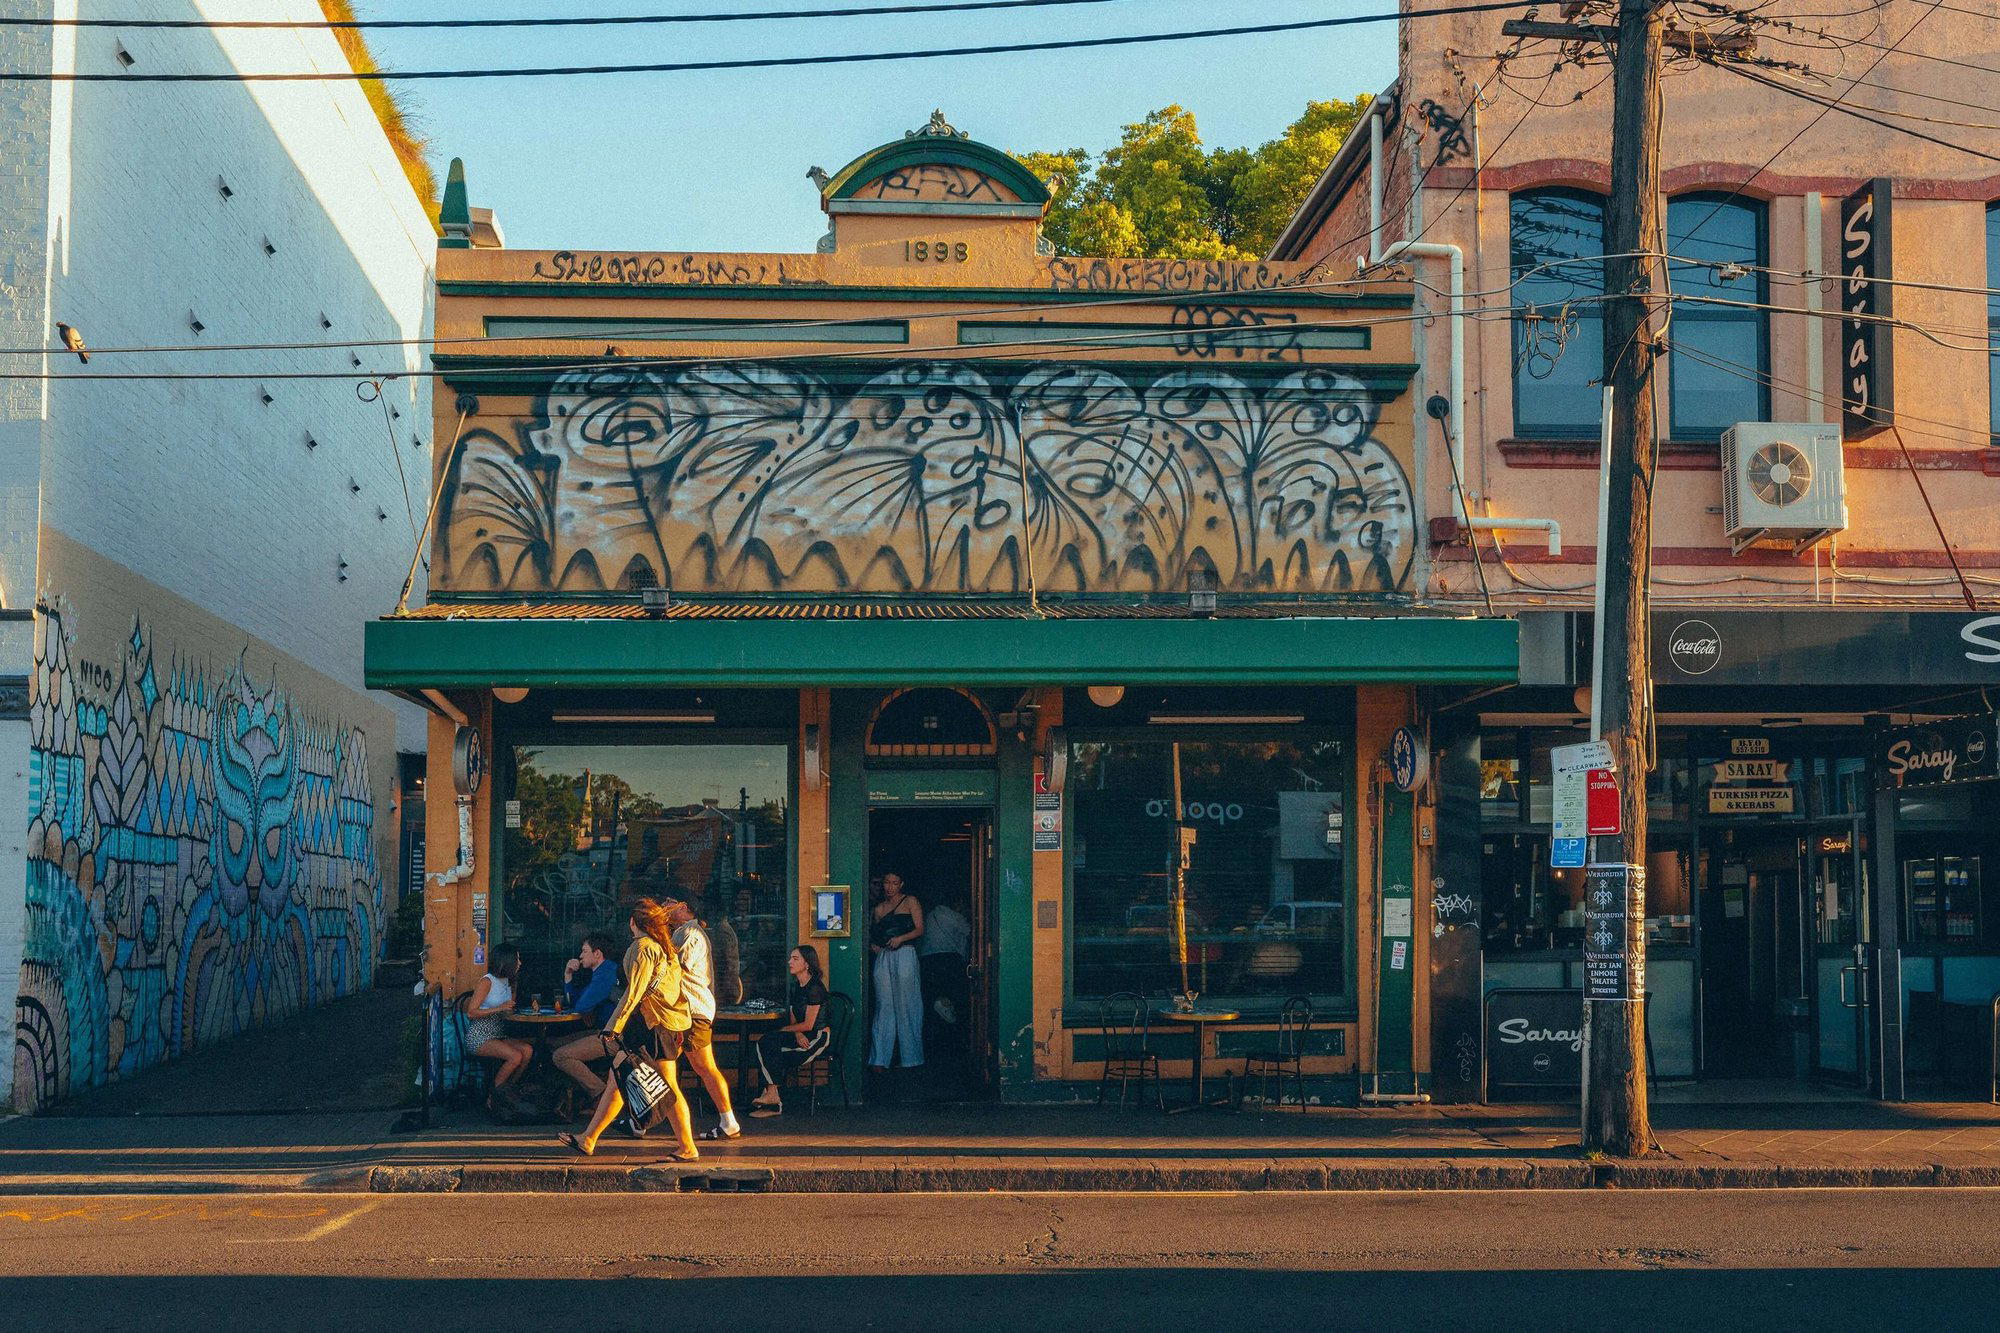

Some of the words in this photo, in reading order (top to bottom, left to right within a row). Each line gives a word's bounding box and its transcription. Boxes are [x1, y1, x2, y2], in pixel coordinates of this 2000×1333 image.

[905, 240, 970, 263] 1898
[1844, 201, 1873, 416] Saray
[1672, 638, 1718, 655] Coca-Cola
[1567, 761, 1603, 771] CLEARWAY
[1887, 740, 1957, 780] Saray
[1598, 771, 1608, 779] NO
[1727, 763, 1773, 776] SARAY
[1712, 791, 1758, 799] TURKISH
[1760, 791, 1789, 799] PIZZA
[1735, 801, 1776, 809] KEBABS
[1498, 1018, 1583, 1052] Saray
